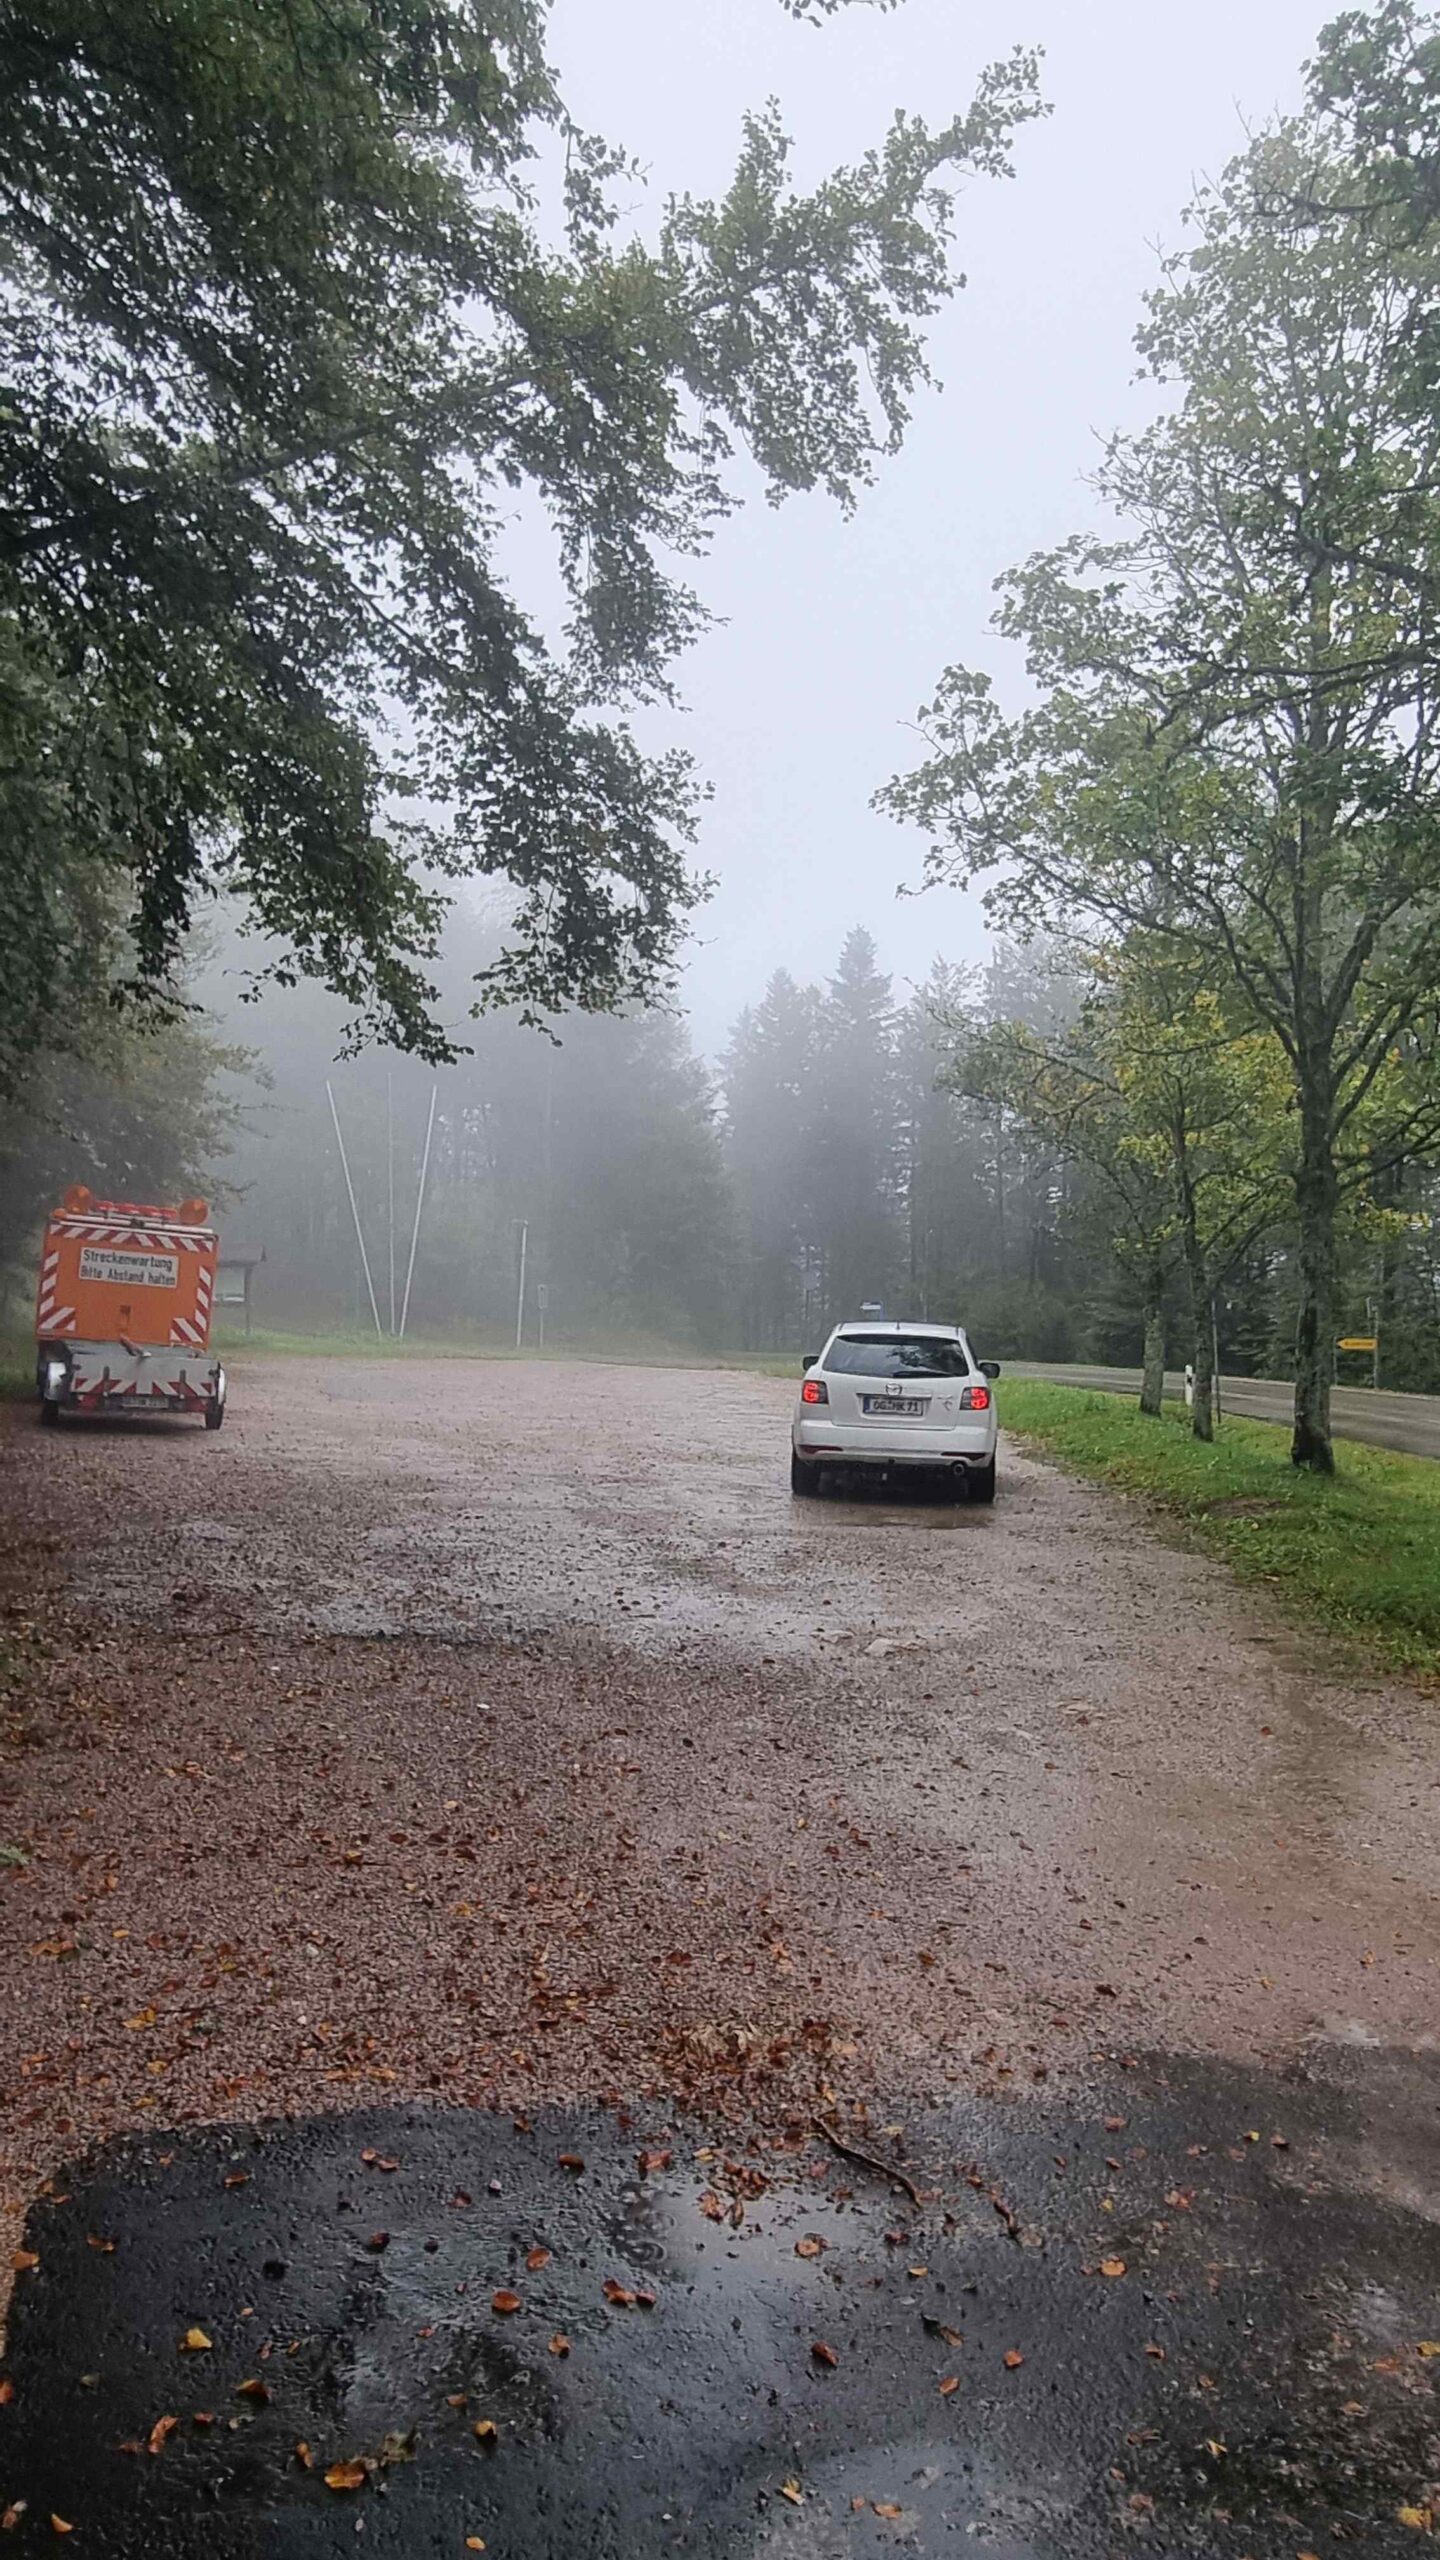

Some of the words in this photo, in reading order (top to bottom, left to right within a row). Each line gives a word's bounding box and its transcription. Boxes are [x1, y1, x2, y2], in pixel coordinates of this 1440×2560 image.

[83, 1249, 173, 1272] Streckenwartung
[81, 1265, 102, 1279] Bitte
[108, 1268, 144, 1282] Abstand
[148, 1271, 176, 1285] halten
